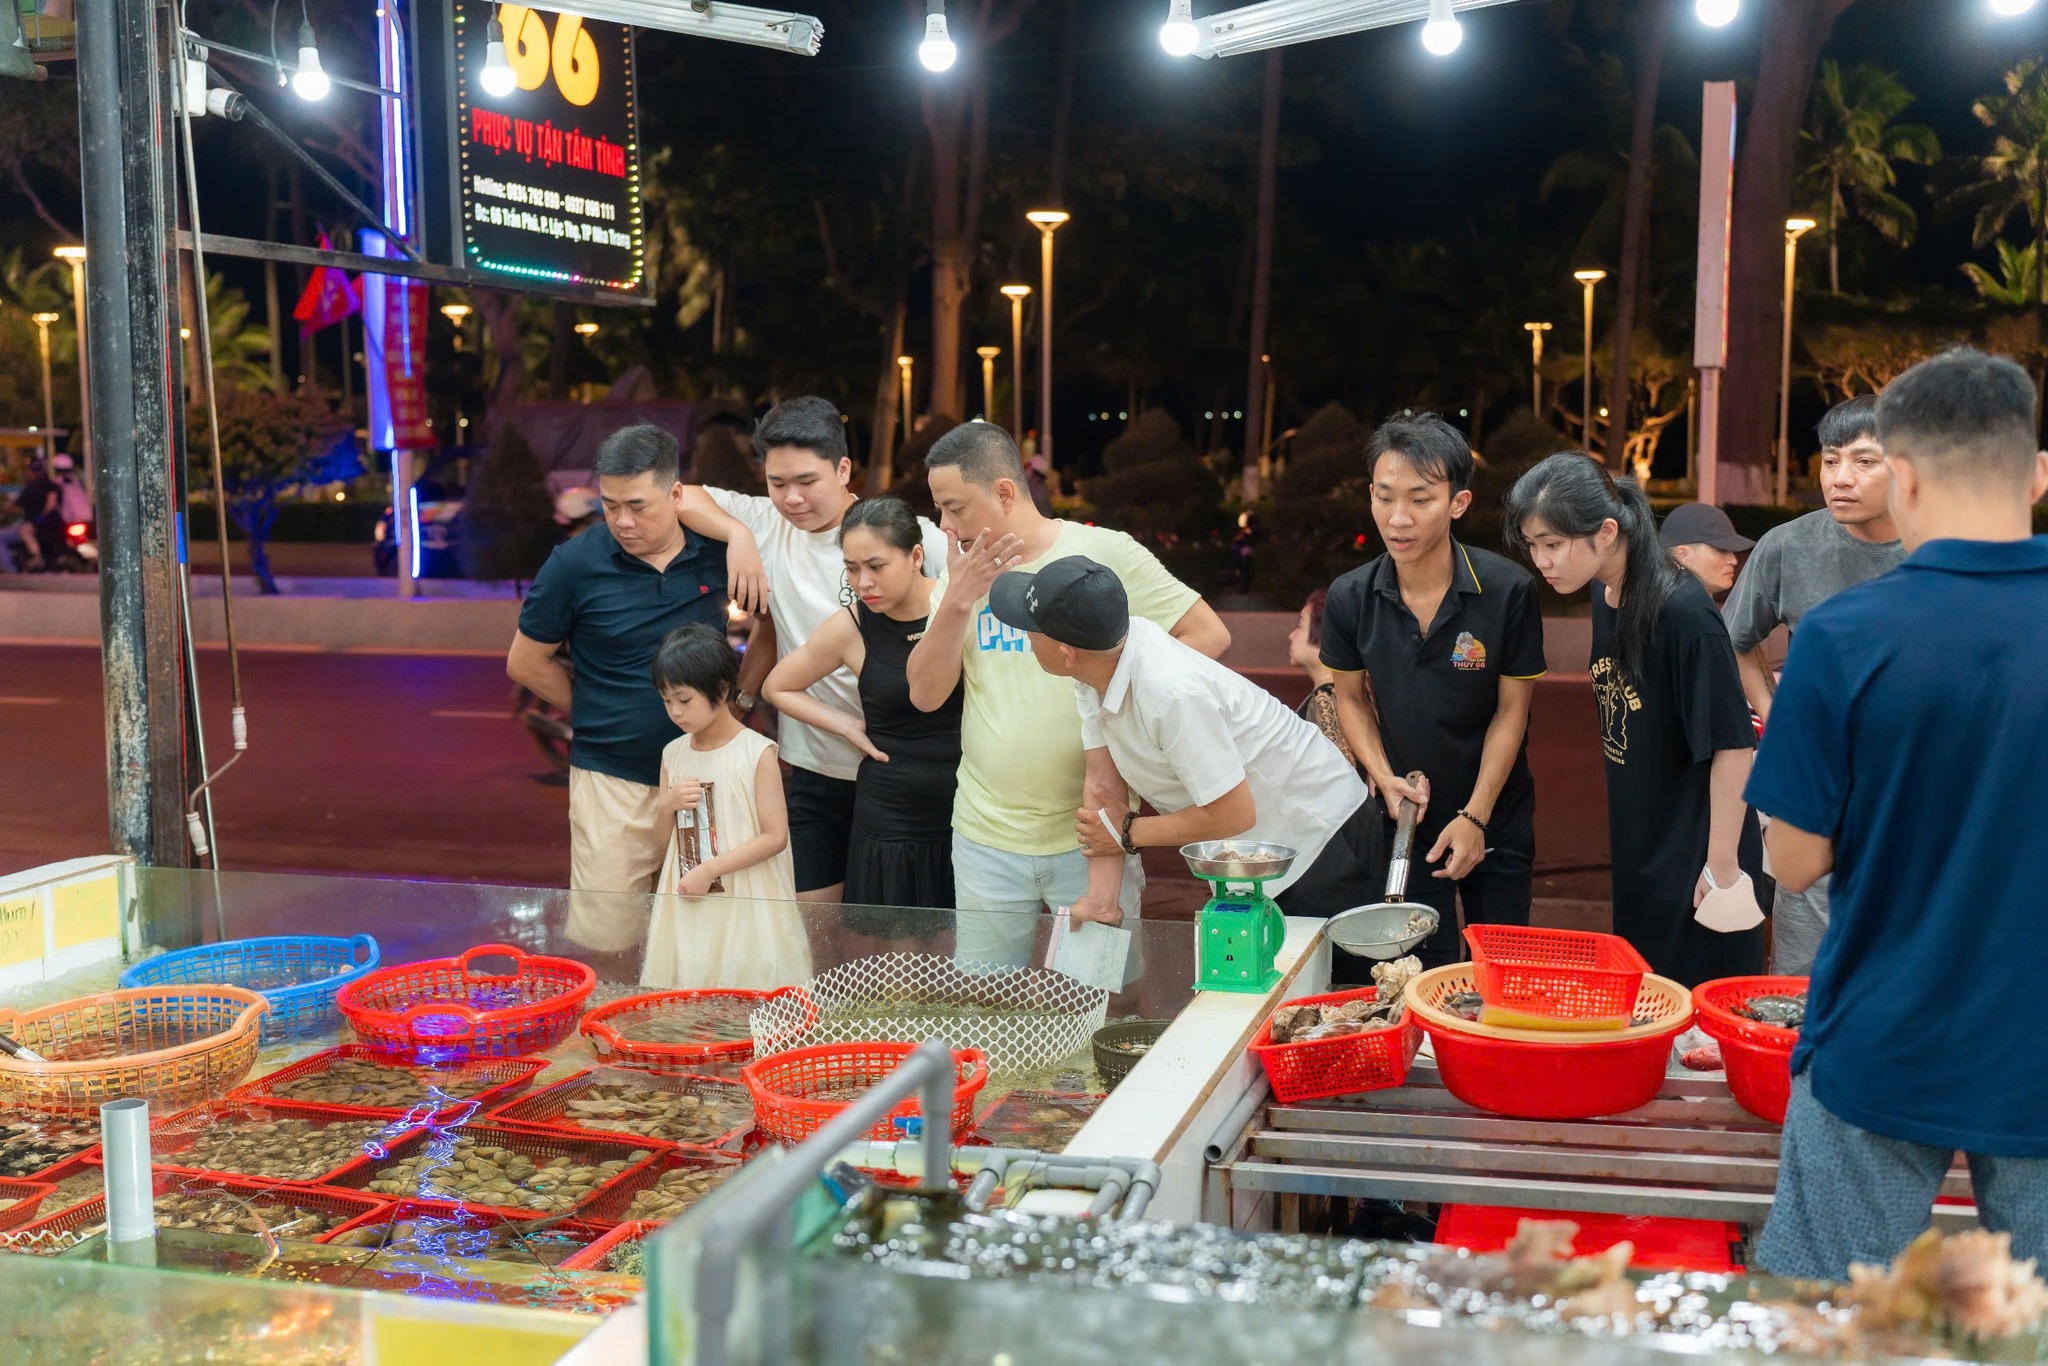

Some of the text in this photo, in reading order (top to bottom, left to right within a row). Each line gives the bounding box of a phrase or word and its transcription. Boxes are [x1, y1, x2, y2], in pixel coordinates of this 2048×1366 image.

[498, 3, 600, 107] 66
[471, 107, 512, 156] PHỤC
[514, 118, 534, 163] VỤ
[600, 202, 616, 221] 111
